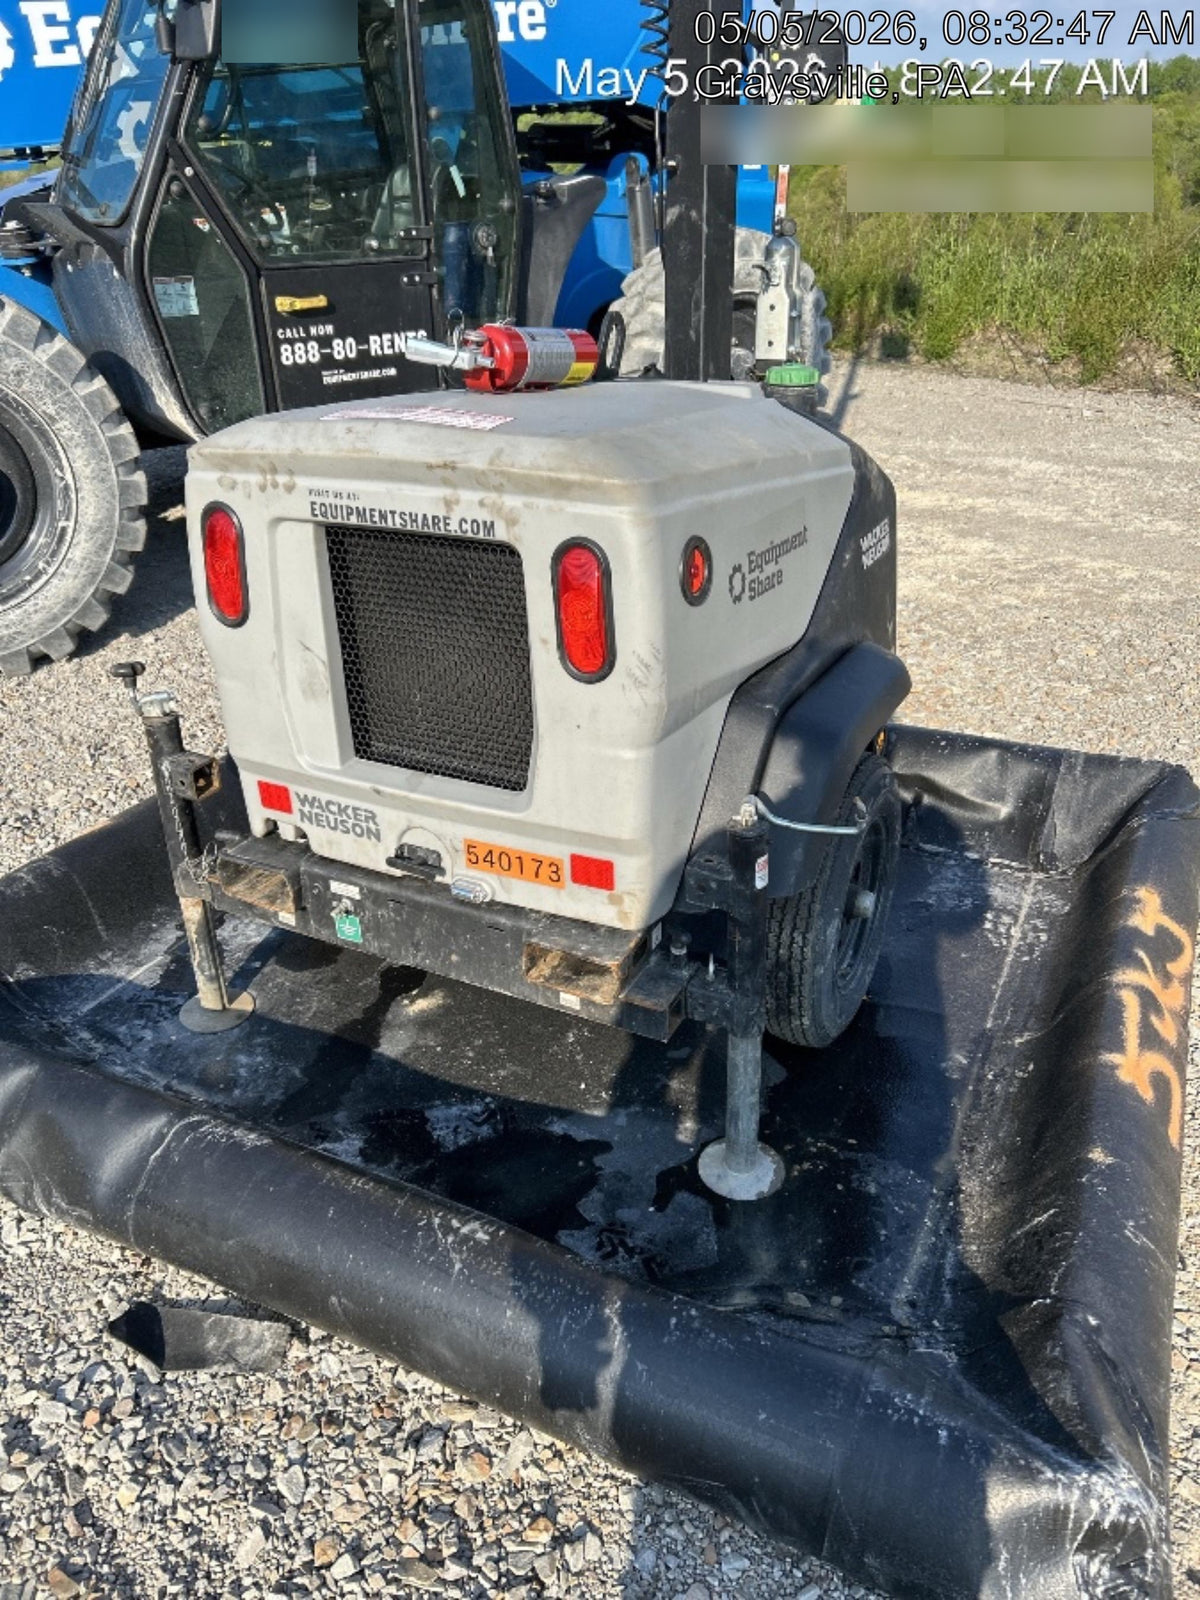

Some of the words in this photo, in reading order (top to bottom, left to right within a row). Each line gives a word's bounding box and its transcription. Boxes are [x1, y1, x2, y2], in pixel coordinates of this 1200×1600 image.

[277, 326, 306, 339] CALL
[310, 324, 334, 337] NOW
[280, 330, 428, 366] 888-80-REN
[310, 501, 496, 538] EQUIPMENTSHARE.COM
[748, 525, 808, 574] Equipment
[749, 568, 784, 601] Share
[295, 792, 378, 827] WACKER
[299, 808, 381, 843] NEUSON
[466, 844, 562, 884] 540173
